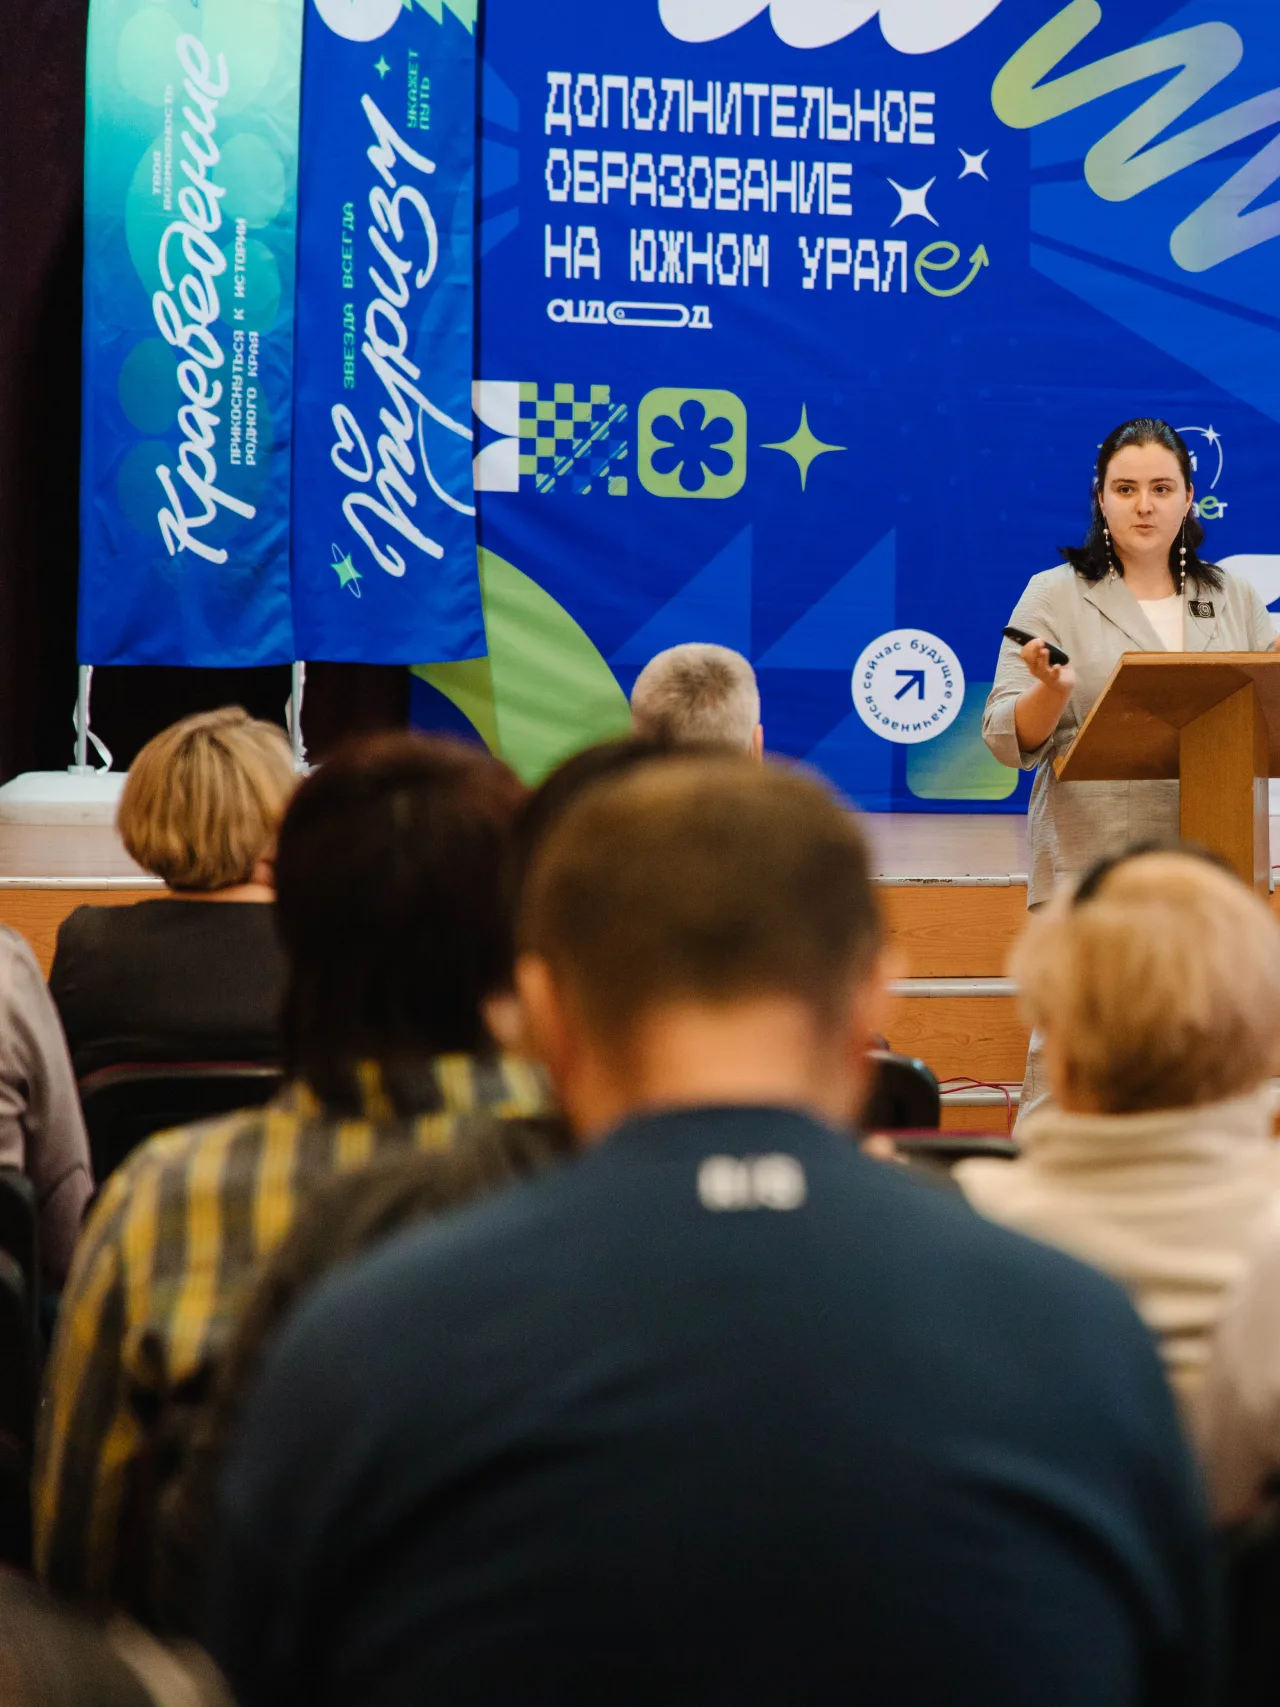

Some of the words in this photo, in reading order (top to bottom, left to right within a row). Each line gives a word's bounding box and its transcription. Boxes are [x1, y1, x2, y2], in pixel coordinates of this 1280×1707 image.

[406, 48, 419, 130] УКАЖЕТ
[418, 76, 431, 131] ПУТЬ
[545, 71, 936, 144] ДОПОЛНИТЕЛЬНОЕ
[545, 148, 853, 216] ОБРАЗОВАНИЕ
[233, 217, 248, 299] ИСТОРИИ
[341, 201, 355, 290] ВСЕГДА
[545, 224, 601, 280] НА
[630, 228, 769, 288] ЮЖНОМ
[233, 307, 246, 321] К
[343, 303, 356, 390] ЗВЕЗДА
[247, 331, 260, 378] КРАЯ
[230, 330, 245, 466] ПРИКОСНУТЬСЯ
[245, 386, 259, 466] РОДНОГО
[863, 641, 902, 689] сейчас
[909, 638, 954, 699] будущее
[865, 694, 948, 733] начинается
